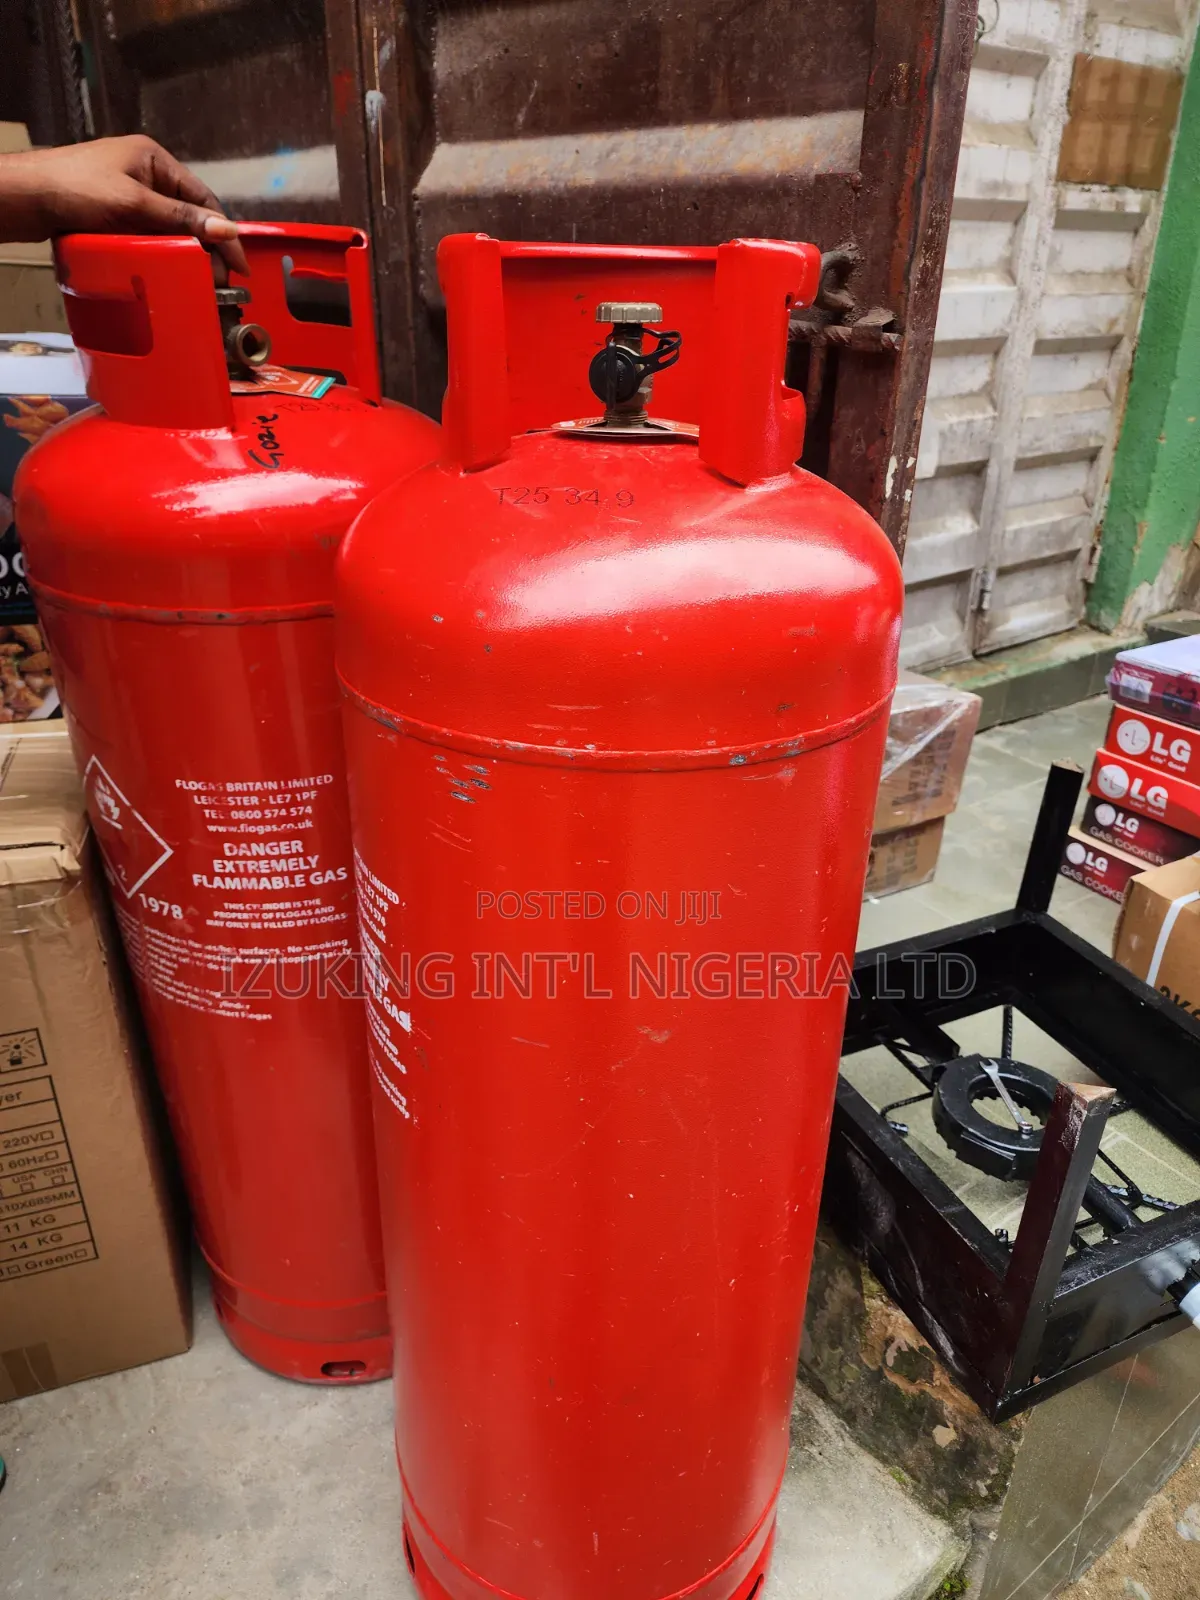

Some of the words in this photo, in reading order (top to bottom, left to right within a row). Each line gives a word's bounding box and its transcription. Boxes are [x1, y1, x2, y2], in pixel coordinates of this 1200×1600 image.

[493, 487, 550, 505] T25
[1152, 732, 1192, 764] LG
[175, 779, 224, 792] FLOGAS
[225, 781, 278, 793] BRITAIN
[281, 774, 334, 790] LIMITED
[269, 794, 291, 805] LE7
[295, 791, 319, 802] 1PF
[1130, 778, 1169, 810] LG
[230, 810, 262, 820] 0800
[264, 808, 287, 818] 574
[289, 805, 313, 816] 574
[1115, 812, 1140, 834] LG
[223, 840, 304, 856] DANGER
[1090, 826, 1113, 843] GAS
[1114, 837, 1165, 865] COOKER
[213, 855, 320, 873] EXTREMELY
[1085, 852, 1109, 873] LG
[192, 873, 306, 890] FLAMMABLE
[309, 867, 348, 885] GAS
[1061, 865, 1084, 881] GAS
[1084, 876, 1127, 902] COOKE
[139, 893, 183, 919] 1978
[213, 910, 260, 919] PROPERTY
[262, 910, 274, 919] OF
[276, 908, 313, 919] FLOGAS
[314, 905, 335, 915] AND
[223, 902, 245, 911] THIS
[304, 898, 322, 906] THE
[225, 921, 249, 929] ONLY
[264, 920, 295, 929] FILLED
[297, 919, 309, 927] BY
[310, 913, 348, 925] FLOGAS
[304, 939, 348, 952] smoking
[8, 1155, 45, 1169] 60Hz
[4, 1222, 20, 1234] 11
[30, 1213, 57, 1229] KG
[10, 1241, 28, 1253] 14
[37, 1233, 63, 1247] KG
[25, 1253, 74, 1271] Green
